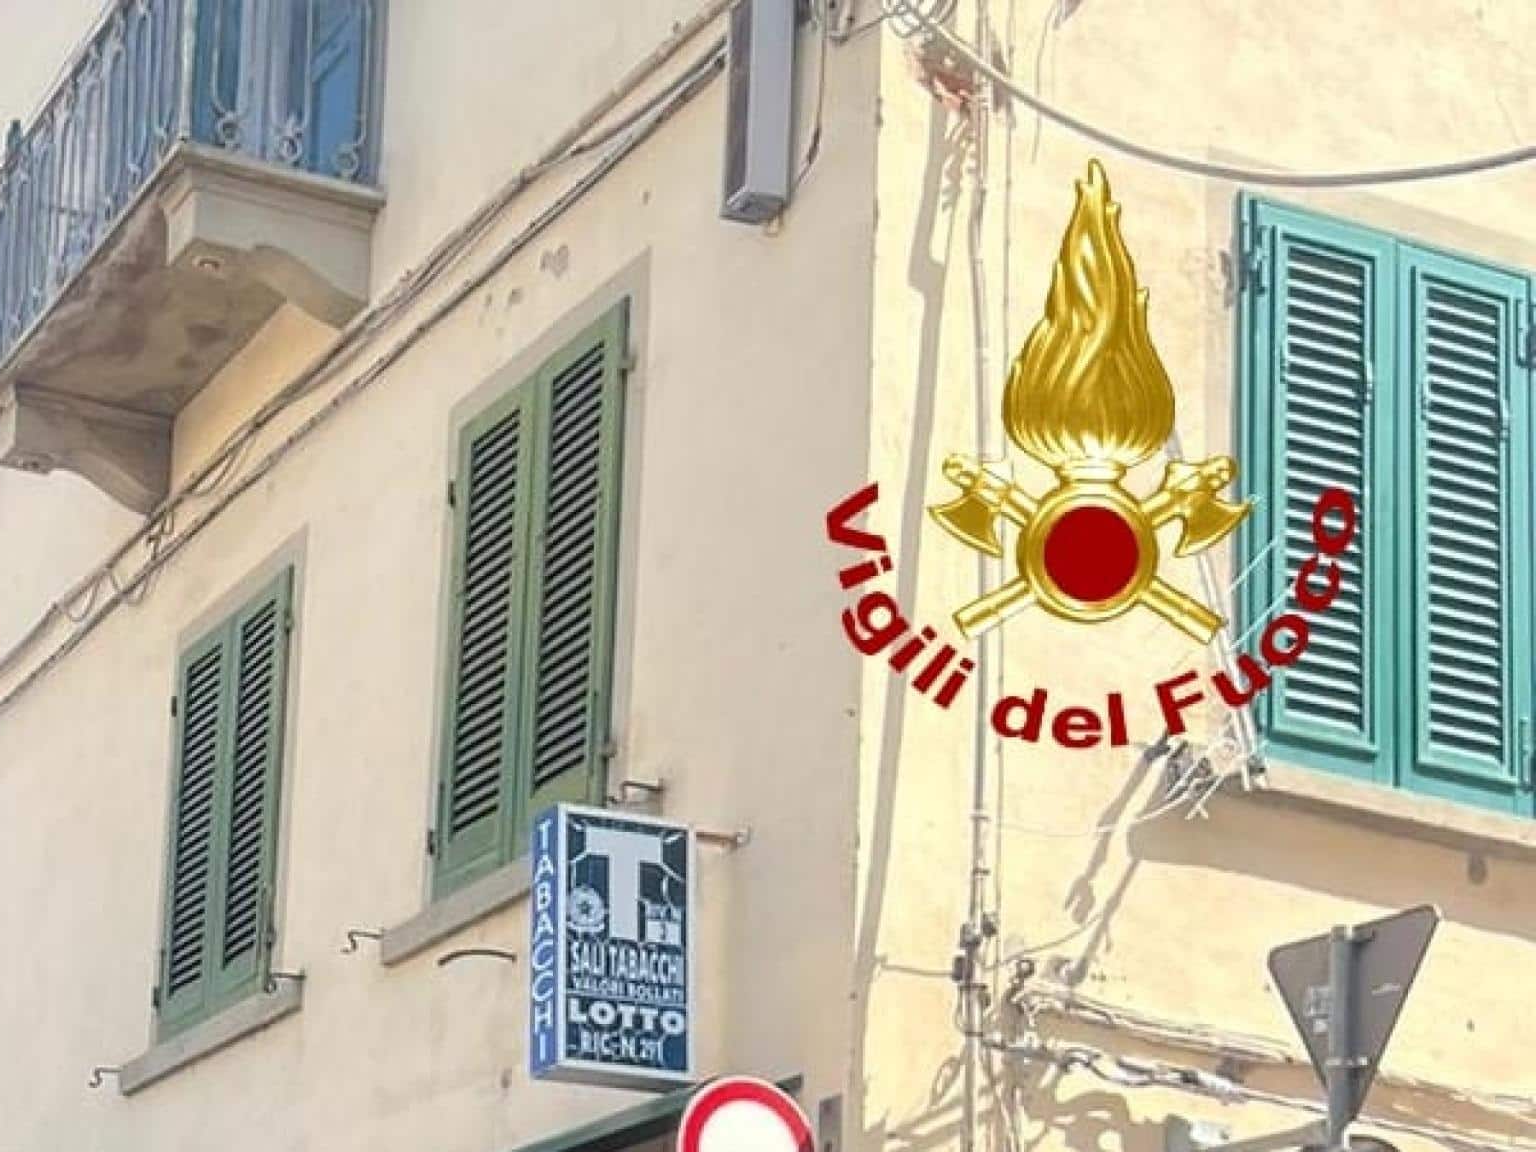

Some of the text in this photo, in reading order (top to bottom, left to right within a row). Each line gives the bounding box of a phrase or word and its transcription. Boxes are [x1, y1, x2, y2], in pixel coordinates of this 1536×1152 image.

[585, 827, 662, 940] T
[532, 817, 555, 1062] TABACCHI
[570, 939, 685, 985] SALI TABACCHI
[567, 997, 685, 1035] LOTTO
